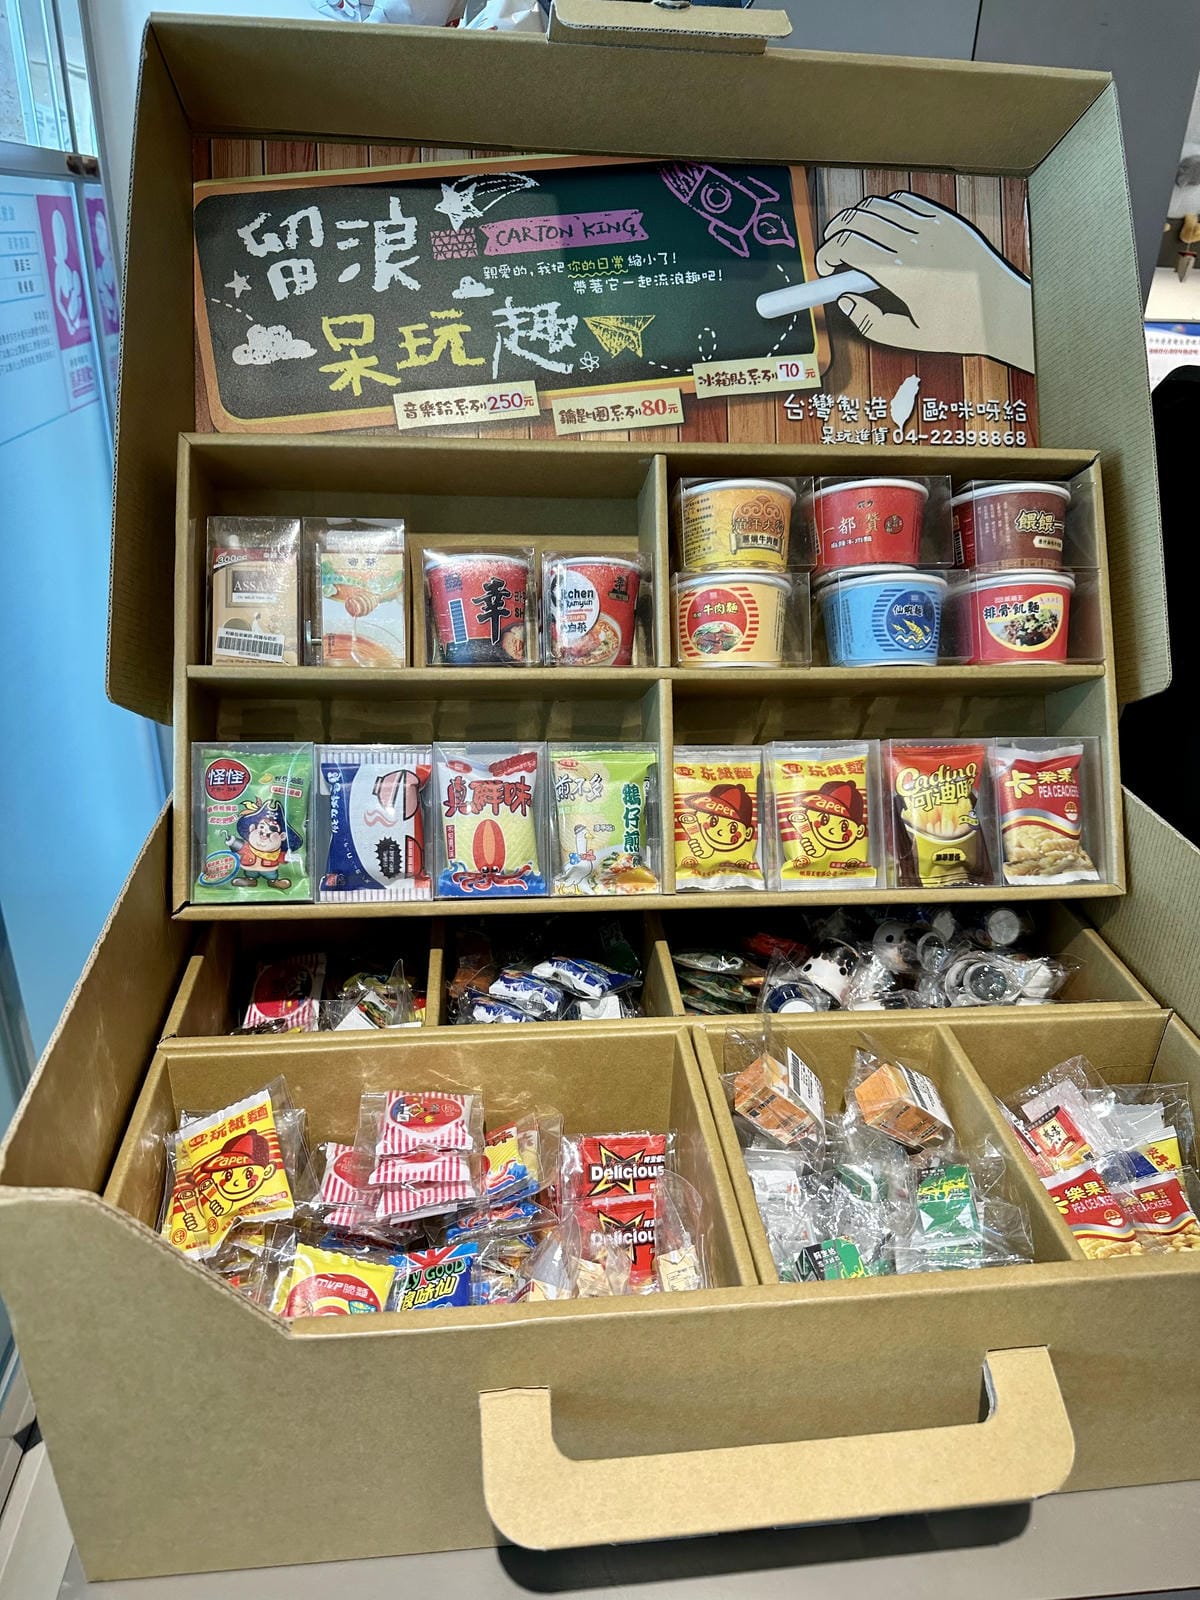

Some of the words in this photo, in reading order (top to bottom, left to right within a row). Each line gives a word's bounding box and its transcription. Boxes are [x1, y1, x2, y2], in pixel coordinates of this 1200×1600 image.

[495, 223, 574, 246] CARTON
[582, 217, 638, 239] KING
[237, 196, 420, 301] 留浪
[319, 296, 579, 397] 呆玩趣
[783, 393, 888, 422] 台灣製造
[922, 398, 1027, 422] 歐咪呀給
[892, 429, 1027, 447] 04-22398868
[703, 602, 738, 616] 牛肉麵
[208, 768, 246, 786] 怪怪
[1038, 785, 1053, 798] PEA
[692, 796, 736, 817] Paper
[802, 795, 847, 815] Paper
[210, 1104, 270, 1142] 玩紙麵
[207, 1155, 250, 1169] Paper
[592, 1163, 665, 1181] Delicious
[425, 1259, 465, 1281] GOOD
